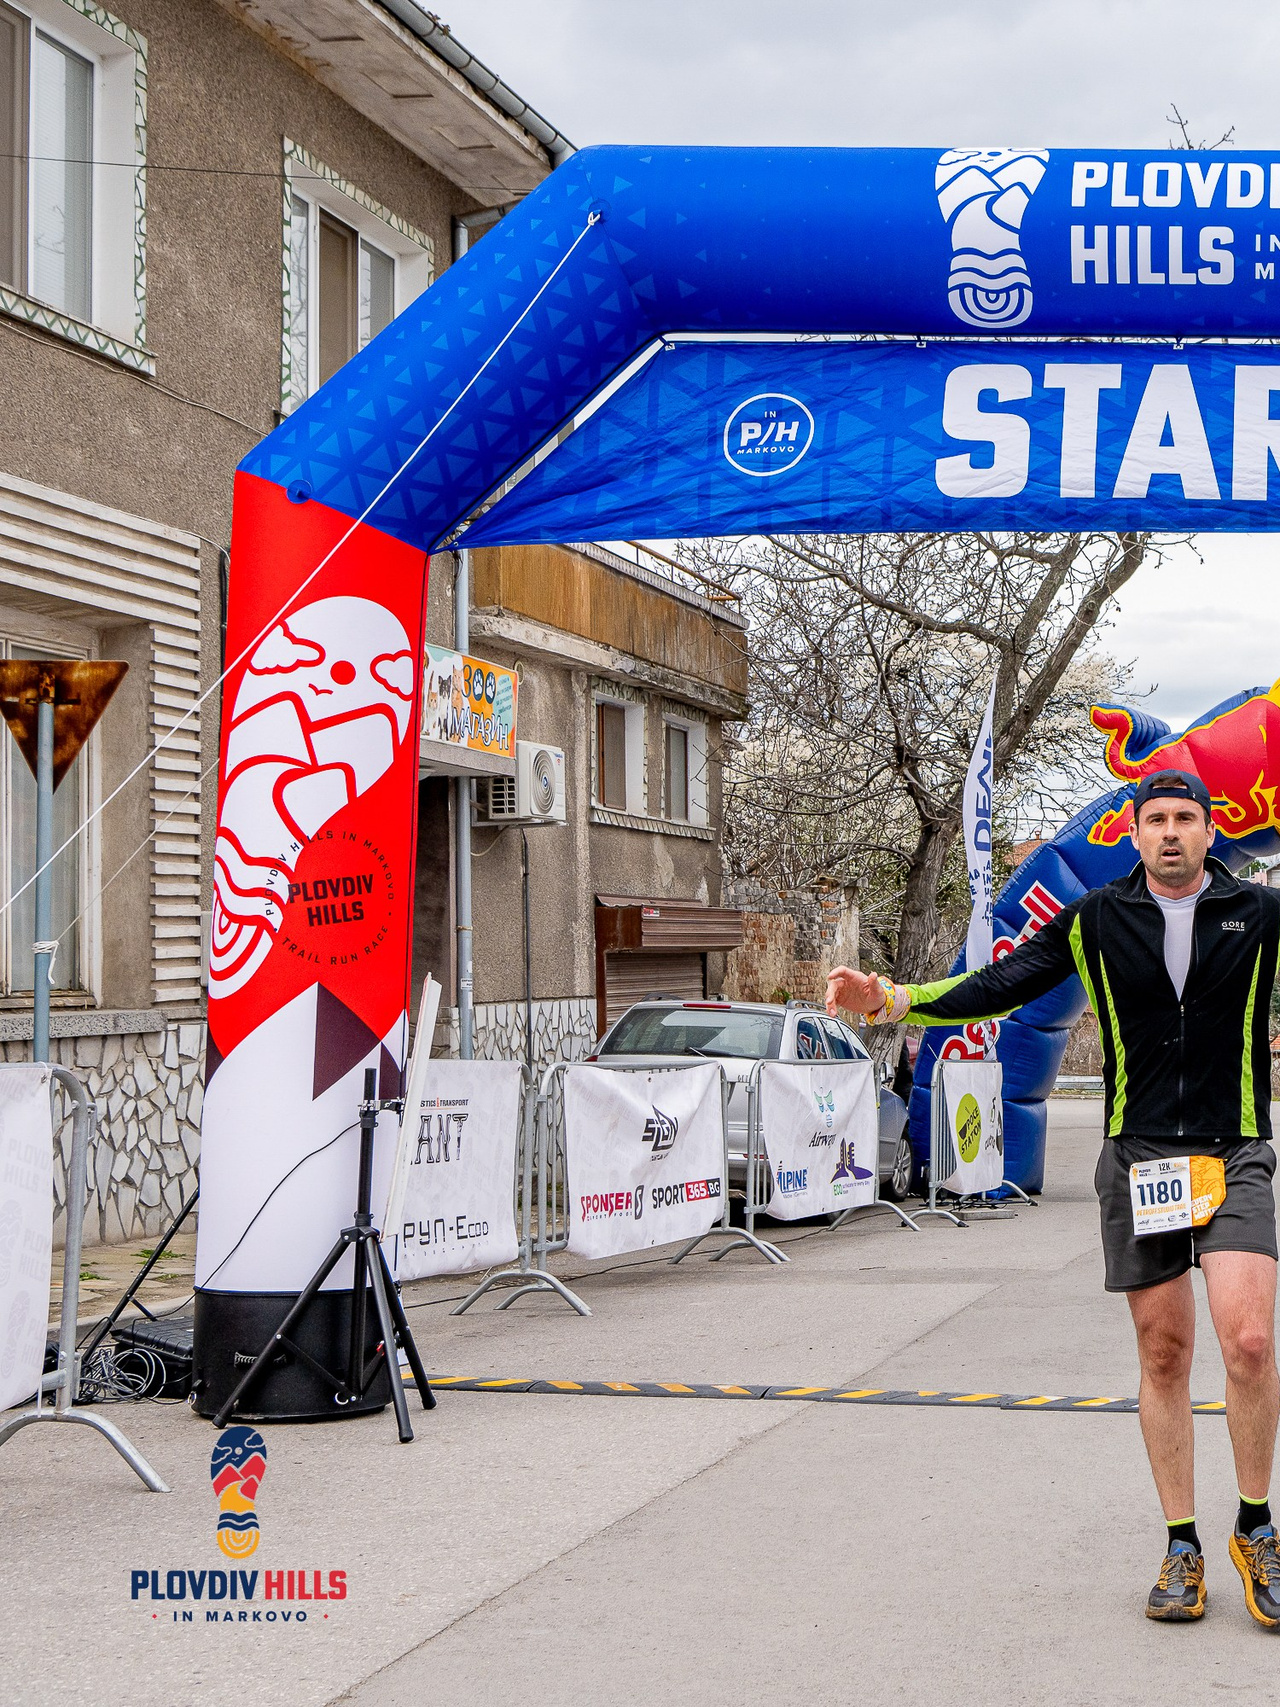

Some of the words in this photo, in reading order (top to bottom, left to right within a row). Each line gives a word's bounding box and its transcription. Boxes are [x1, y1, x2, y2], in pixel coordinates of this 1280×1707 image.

[1071, 225, 1234, 285] HILLS
[764, 410, 777, 418] IN
[740, 421, 800, 447] P/H
[736, 445, 795, 455] MARKOVO
[451, 706, 509, 751] МАГАЗИН
[265, 854, 287, 916] PLOVDIV
[290, 830, 334, 852] HILLS
[342, 831, 357, 841] IN
[363, 840, 394, 900] MARKOVO
[288, 874, 374, 904] PLOVDIV
[306, 901, 364, 927] HILLS
[282, 937, 321, 964] TRAIL
[330, 954, 358, 965] RUN
[364, 925, 388, 954] RACE
[413, 1113, 469, 1165] ANT
[1137, 1179, 1182, 1206] 1180
